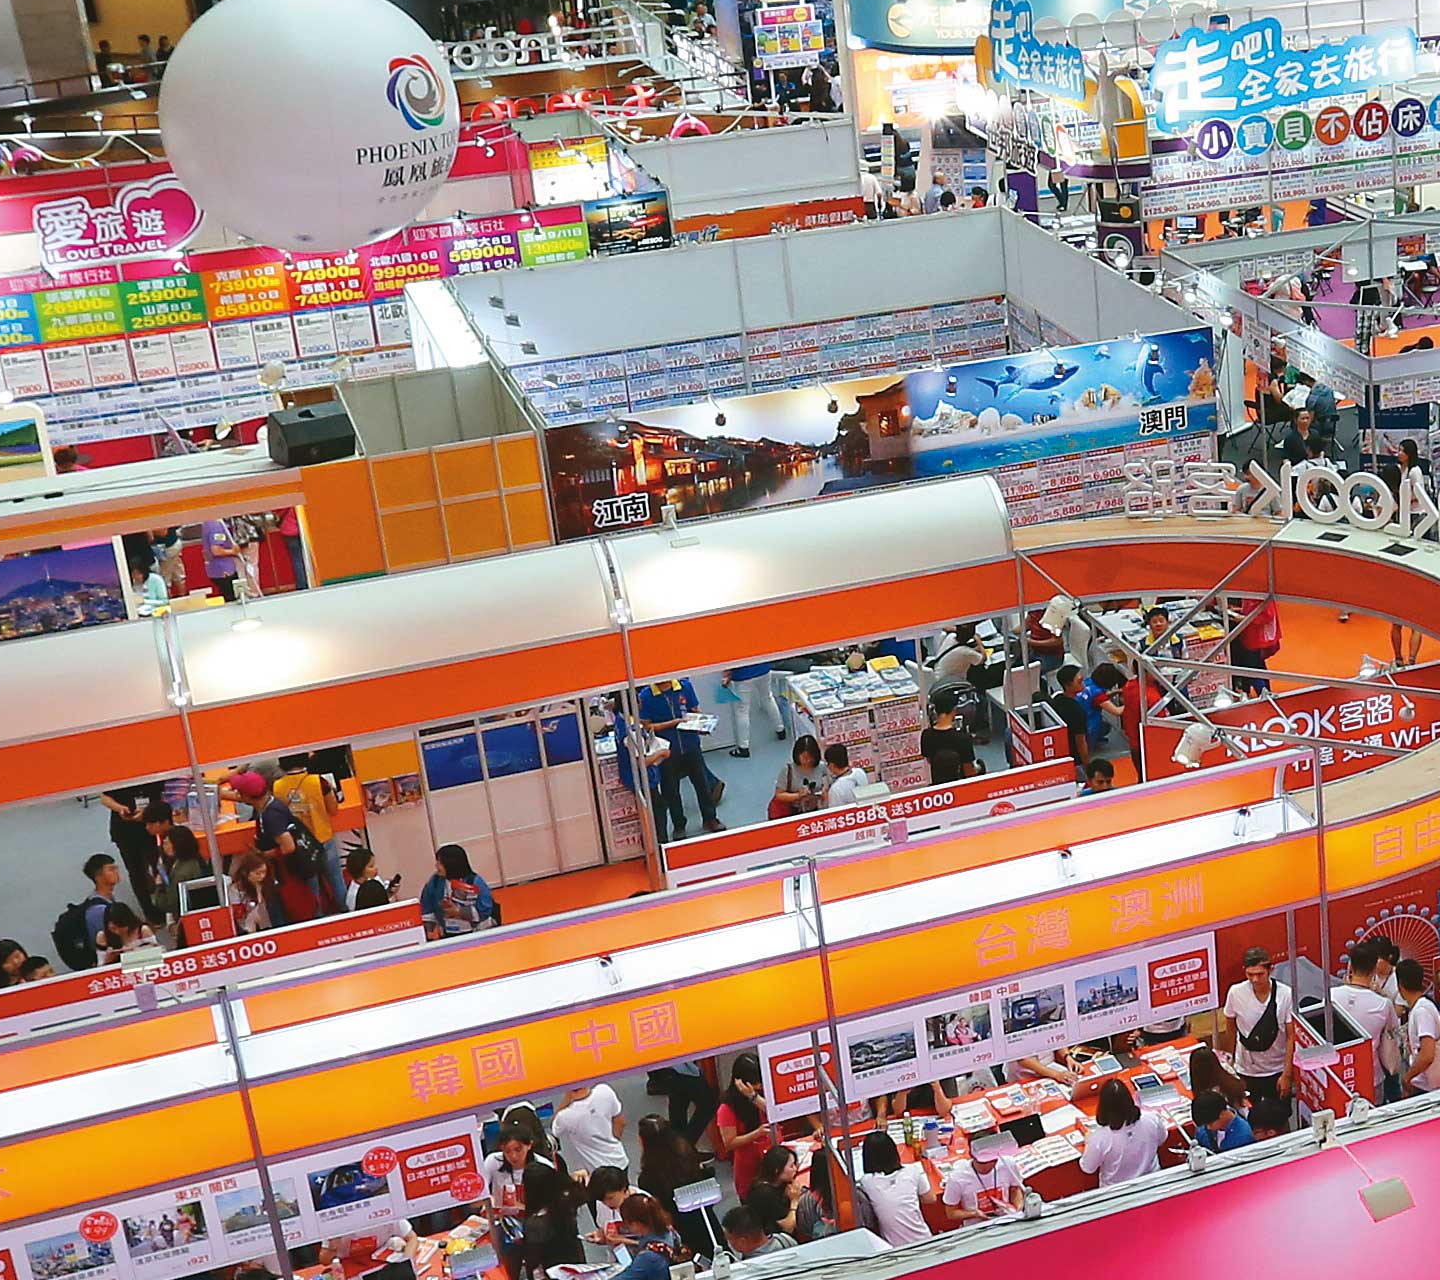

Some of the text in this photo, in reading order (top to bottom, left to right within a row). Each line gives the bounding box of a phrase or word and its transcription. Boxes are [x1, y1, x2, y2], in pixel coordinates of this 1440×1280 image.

[1237, 36, 1417, 109] 全家去旅行
[356, 139, 438, 167] PHOENIX
[39, 202, 167, 250] 愛旅遊
[1138, 403, 1190, 441] 澳門
[592, 491, 650, 529] 江南
[1338, 693, 1394, 733] 客路
[971, 872, 1206, 968] 台灣 澳洲
[200, 939, 279, 969] 送$1000
[407, 1001, 685, 1104] 韓國 中國
